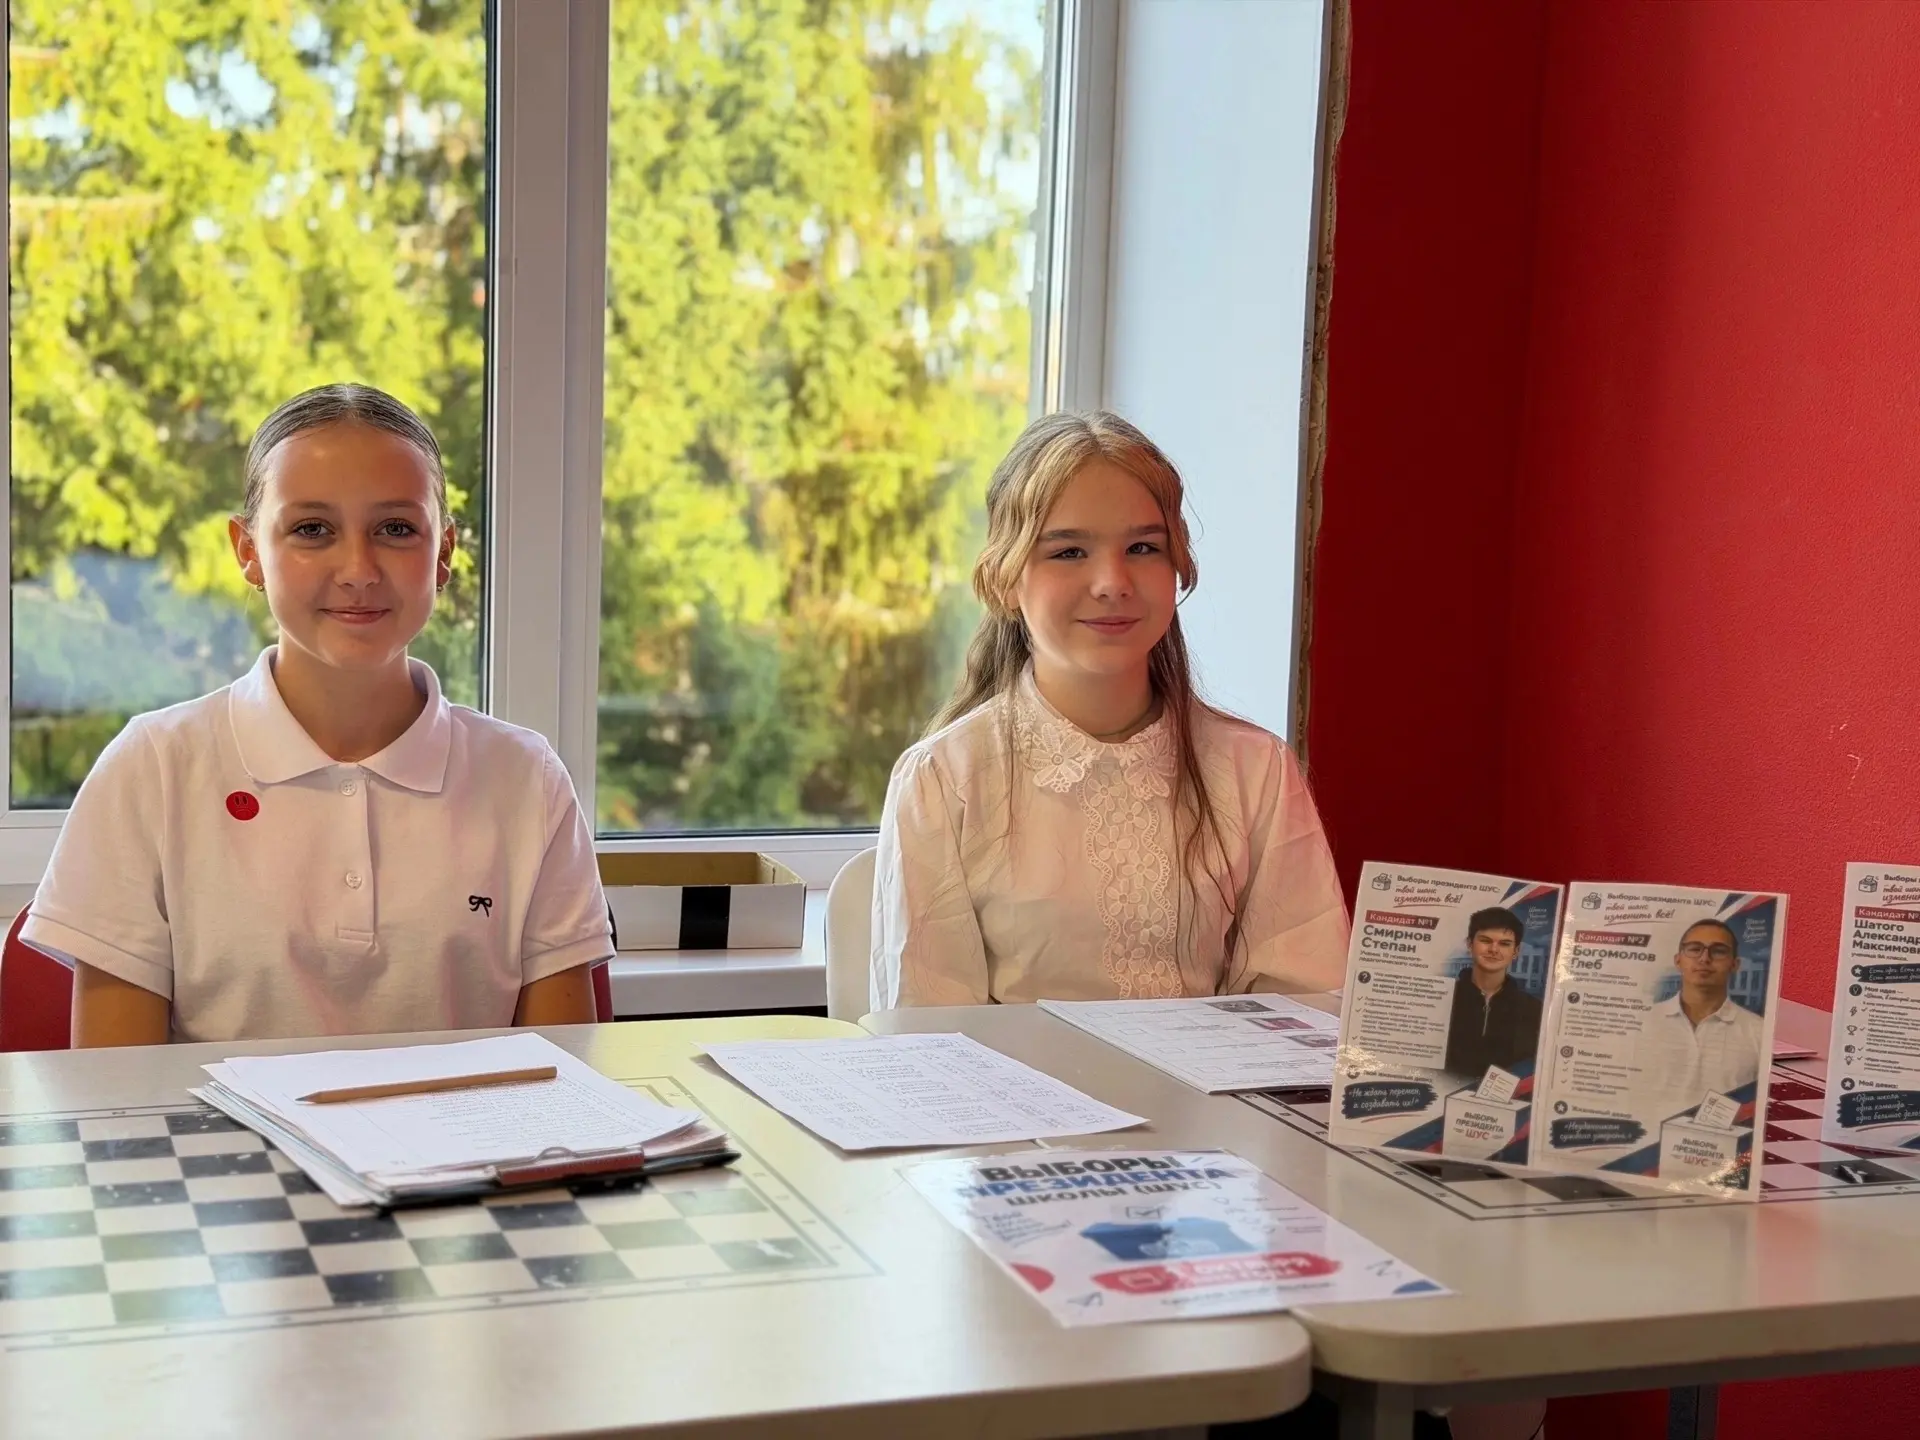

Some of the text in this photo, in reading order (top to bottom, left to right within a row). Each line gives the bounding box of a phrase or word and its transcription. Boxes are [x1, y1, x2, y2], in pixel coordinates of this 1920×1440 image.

[1397, 875, 1428, 885] Выборы
[1431, 879, 1477, 891] президента
[1884, 874, 1917, 883] Выборы
[1395, 885, 1415, 894] твой
[1394, 894, 1463, 904] изменить всё!
[1607, 892, 1640, 902] Выборы
[1642, 896, 1692, 906] президента
[1606, 902, 1625, 911] твой
[1369, 913, 1433, 926] Кандидат №1
[1604, 909, 1675, 922] изменить всё!
[1859, 909, 1905, 919] Кандидат
[1855, 920, 1904, 931] Шатого
[1363, 925, 1432, 942] Смирнов
[1578, 932, 1645, 945] Кандидат №2
[1361, 937, 1417, 953] Степан
[1572, 945, 1656, 962] Богомолов
[1571, 958, 1602, 969] Глеб
[1874, 1101, 1905, 1111] команда
[1464, 1112, 1498, 1123] ВЫБОРЫ
[1456, 1118, 1504, 1133] ПРЕЗИДЕНТА
[1465, 1129, 1490, 1140] ШУС
[1682, 1138, 1718, 1150] ВЫБОРЫ
[1673, 1144, 1724, 1160] ПРЕЗИДЕНТА
[1684, 1155, 1709, 1167] ШУС
[978, 1155, 1186, 1182] ВЫБОРЫ
